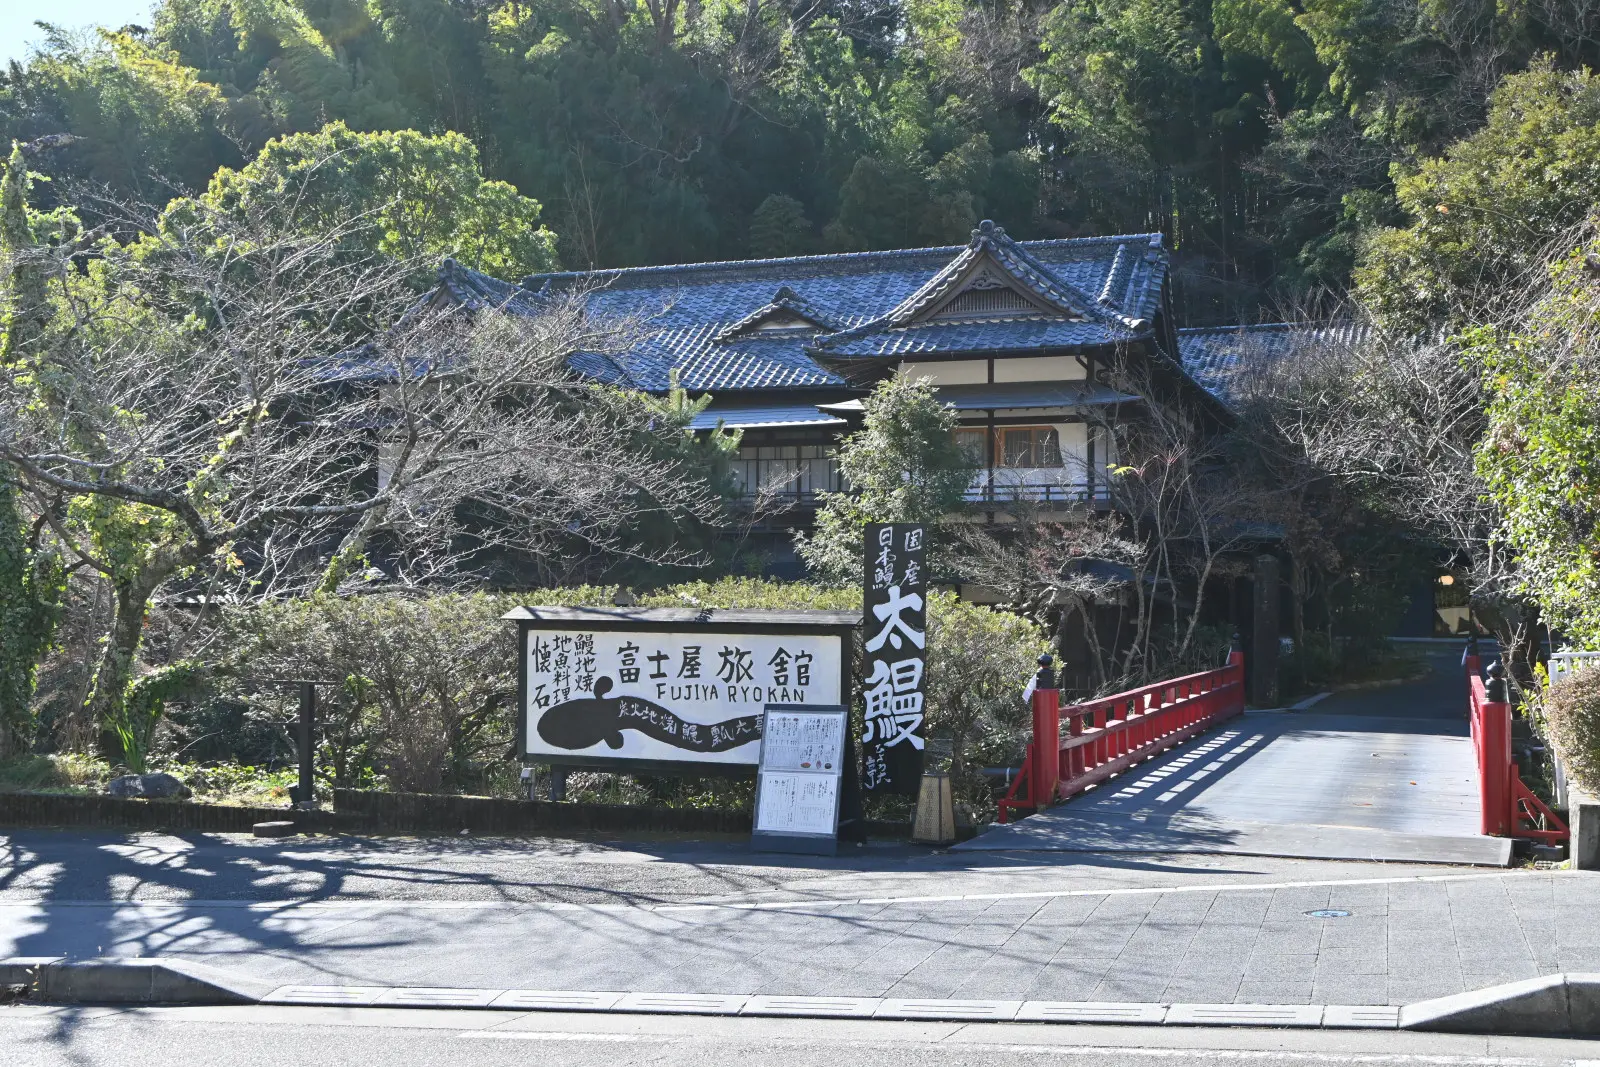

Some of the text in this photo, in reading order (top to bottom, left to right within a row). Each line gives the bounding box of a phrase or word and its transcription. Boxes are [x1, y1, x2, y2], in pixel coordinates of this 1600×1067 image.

[871, 526, 898, 590] 日本鰻
[899, 528, 923, 587] 国産
[552, 634, 573, 705] 地魚料理
[656, 683, 804, 703] FUJIYA RYOKAN
[862, 585, 926, 750] 太鰻
